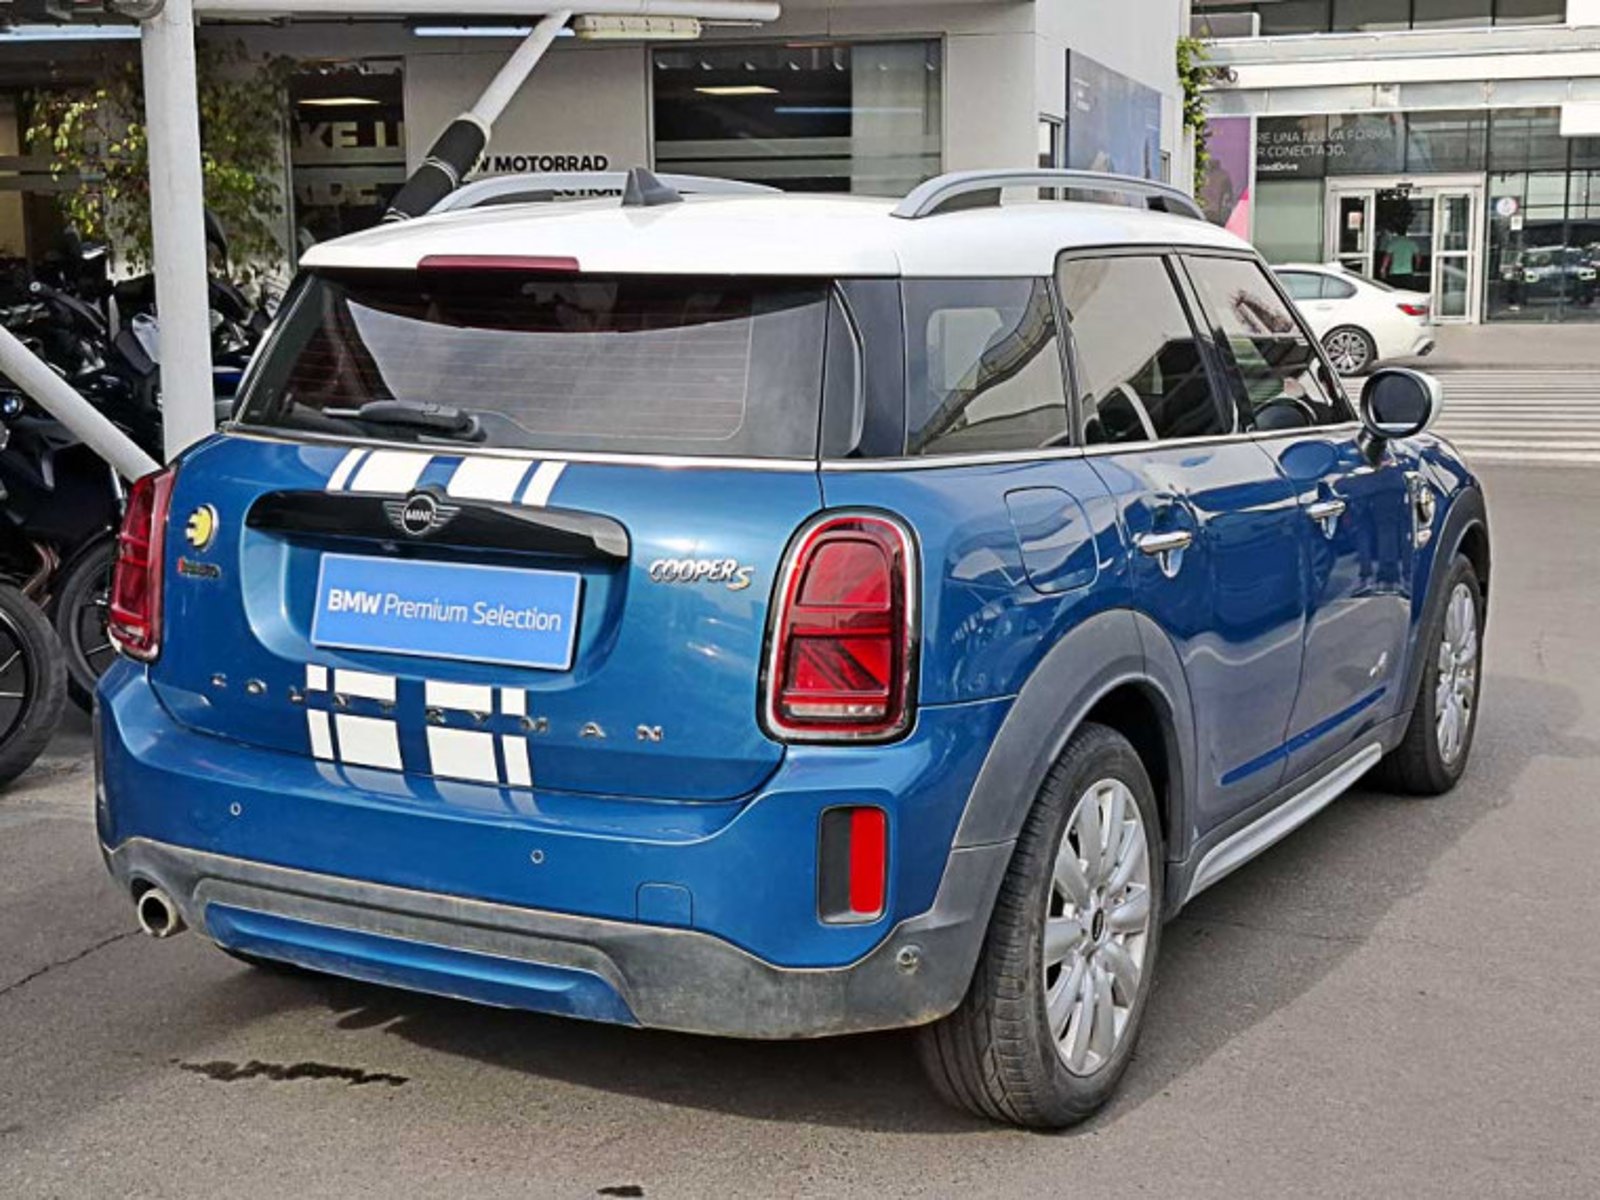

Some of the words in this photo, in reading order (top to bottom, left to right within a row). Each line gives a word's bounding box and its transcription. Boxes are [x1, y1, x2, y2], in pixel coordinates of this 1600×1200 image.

[1273, 131, 1300, 143] UNA
[494, 155, 609, 172] MOTORRAD
[404, 508, 435, 522] MINI
[649, 558, 737, 583] COOPER
[726, 564, 755, 591] S
[327, 588, 382, 614] BMW
[383, 592, 468, 623] Premium
[472, 601, 561, 631] Selection
